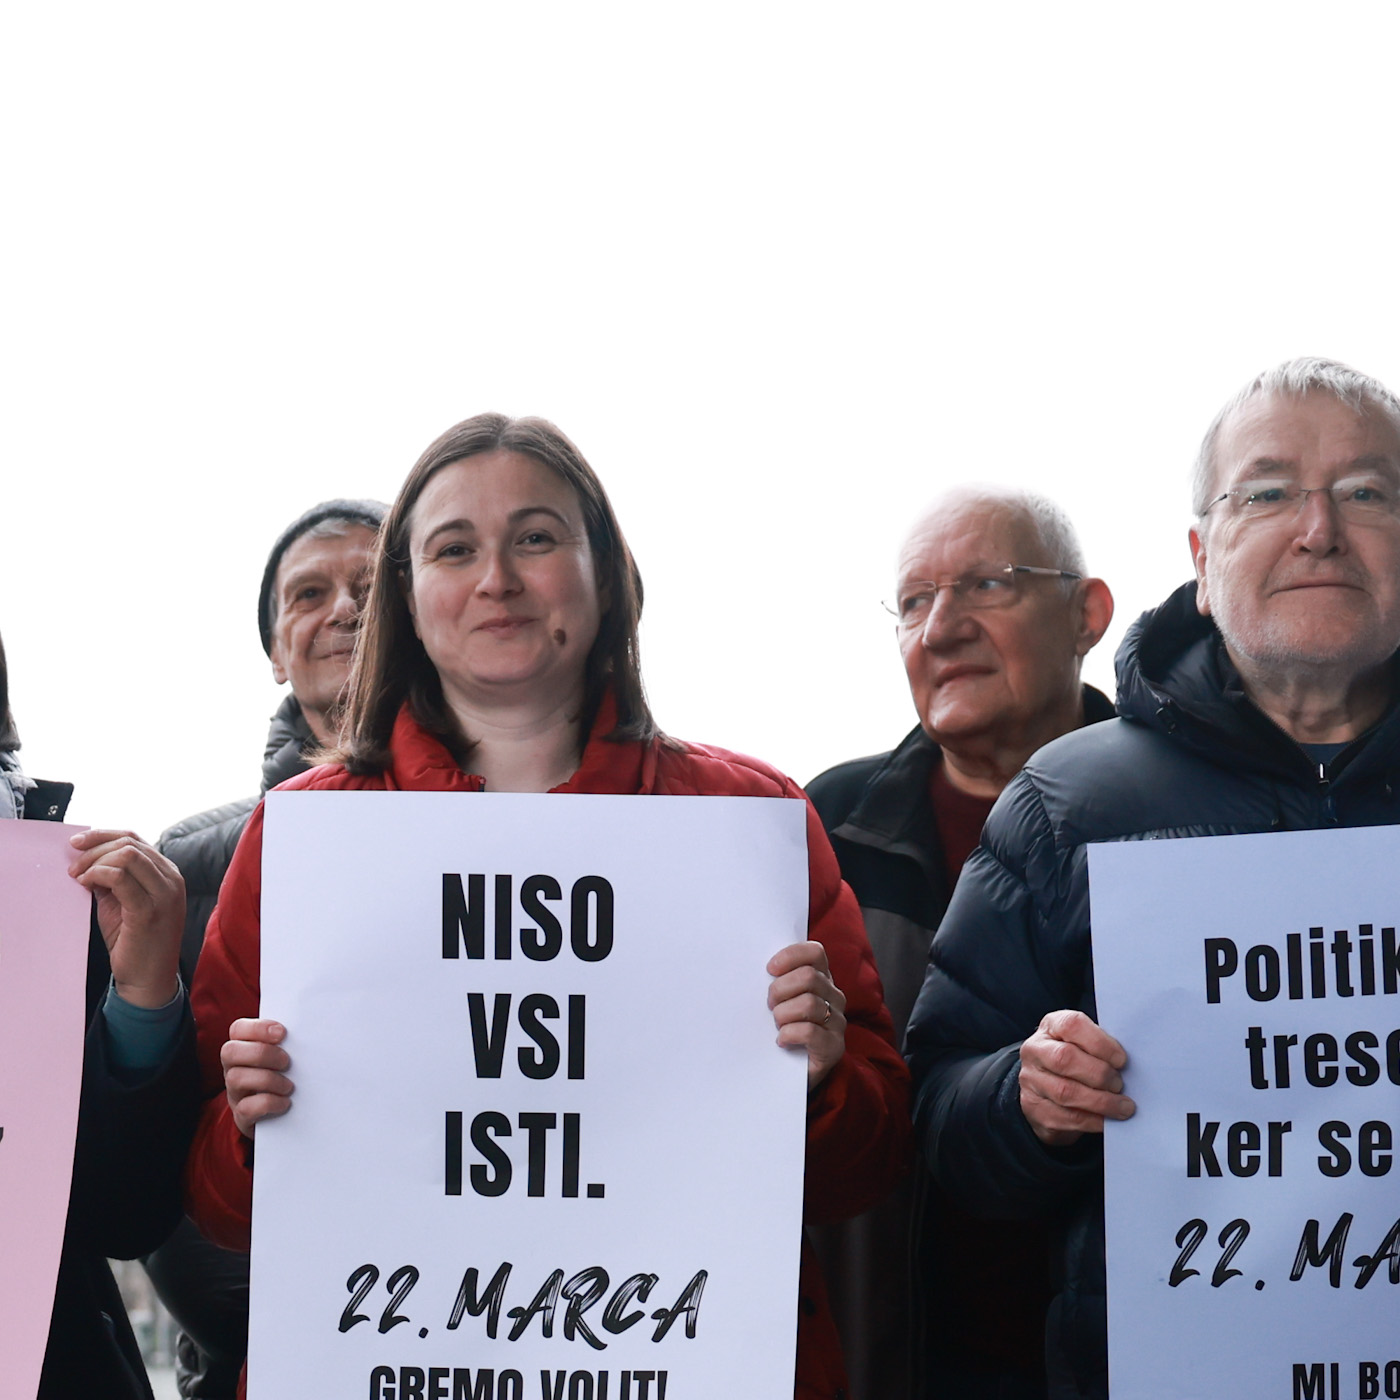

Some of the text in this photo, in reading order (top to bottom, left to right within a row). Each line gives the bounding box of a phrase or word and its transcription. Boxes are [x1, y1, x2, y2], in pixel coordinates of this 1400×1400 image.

[442, 873, 614, 962] NISO
[467, 993, 585, 1080] VSI
[445, 1111, 605, 1198] ISTI.
[1187, 1113, 1292, 1177] ker
[1318, 1121, 1392, 1177] se
[1168, 1219, 1265, 1291] 22.
[338, 1262, 708, 1350] 22. MARCA
